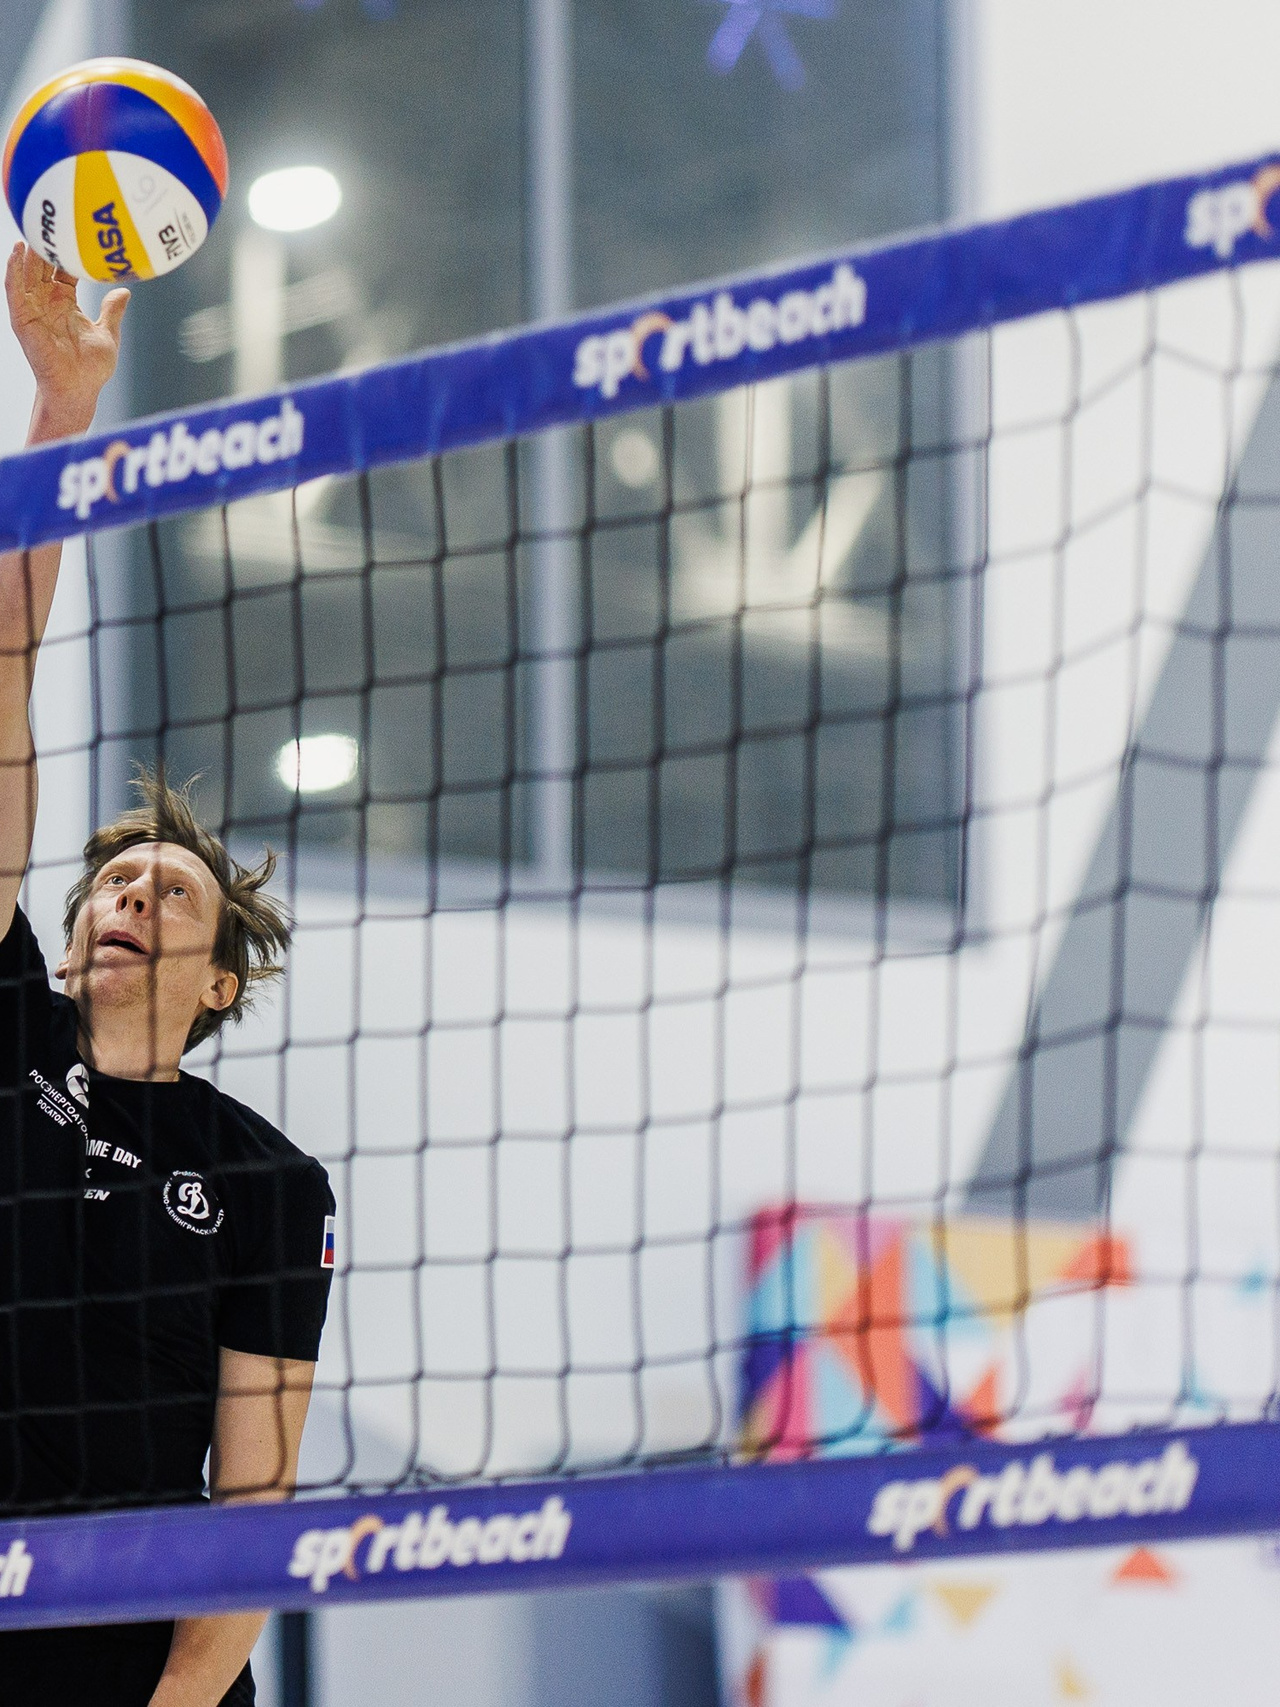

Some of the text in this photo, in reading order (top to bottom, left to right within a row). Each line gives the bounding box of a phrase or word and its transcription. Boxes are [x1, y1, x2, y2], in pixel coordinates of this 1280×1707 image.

[41, 200, 56, 249] PRO
[92, 202, 134, 280] KASA
[29, 1069, 88, 1140] РОСЭНЕРГОАТО
[37, 1099, 67, 1126] РОСАТОМ
[86, 1139, 142, 1169] ME DAY
[84, 1189, 110, 1201] EN
